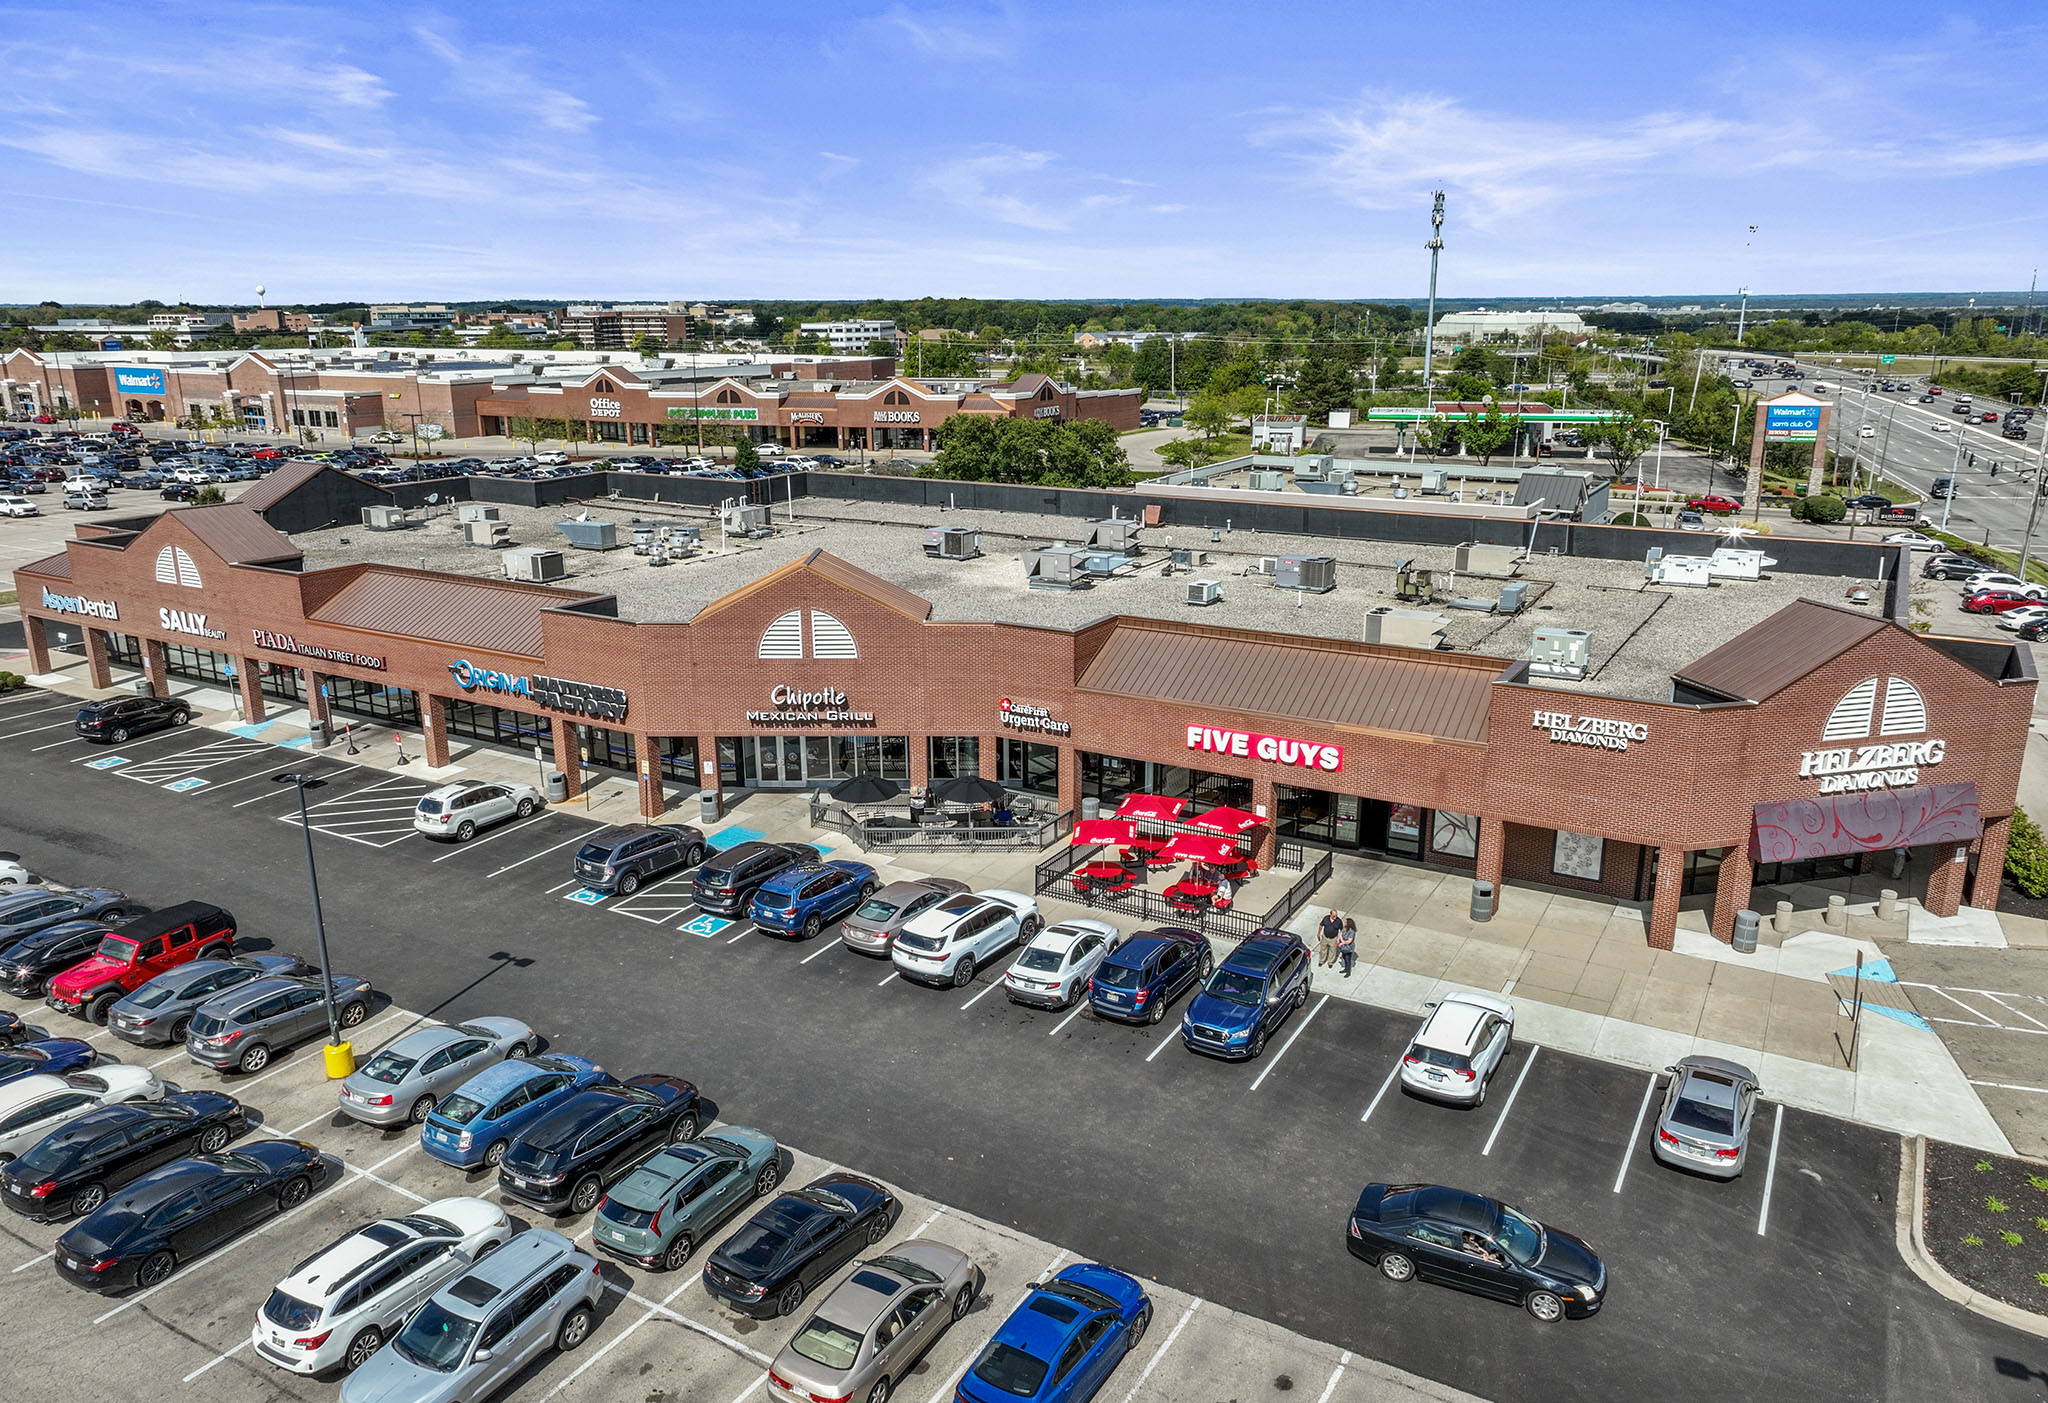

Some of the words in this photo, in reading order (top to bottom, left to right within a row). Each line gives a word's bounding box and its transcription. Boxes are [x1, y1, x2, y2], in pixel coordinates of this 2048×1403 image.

[119, 374, 150, 387] Walmart
[590, 398, 621, 410] Office
[591, 409, 621, 418] DEPOT
[733, 409, 757, 419] PLUS
[1773, 408, 1806, 416] Walmart
[888, 411, 921, 423] BOOKS
[159, 607, 207, 636] SALLY
[205, 628, 227, 641] BEAUTY
[252, 629, 297, 652] PIADA
[298, 644, 327, 657] ITALIAN
[328, 649, 355, 663] STREET
[356, 655, 381, 668] FOOD
[532, 674, 628, 704] MATTRESS
[770, 684, 847, 710] Chipotle
[533, 690, 627, 719] FACTORY
[746, 710, 818, 721] MEXICAN
[826, 711, 874, 721] GRILL
[1010, 703, 1050, 717] CareFirst
[1000, 711, 1040, 728] Urgent
[1042, 717, 1070, 732] Care
[1532, 710, 1649, 741] HELZBERG
[1187, 726, 1250, 756] FIVE
[1256, 737, 1340, 771] GUYS
[1550, 729, 1629, 751] DIAMONDS
[1798, 740, 1946, 777] HELZBERG
[1818, 768, 1920, 794] DIAMONDS
